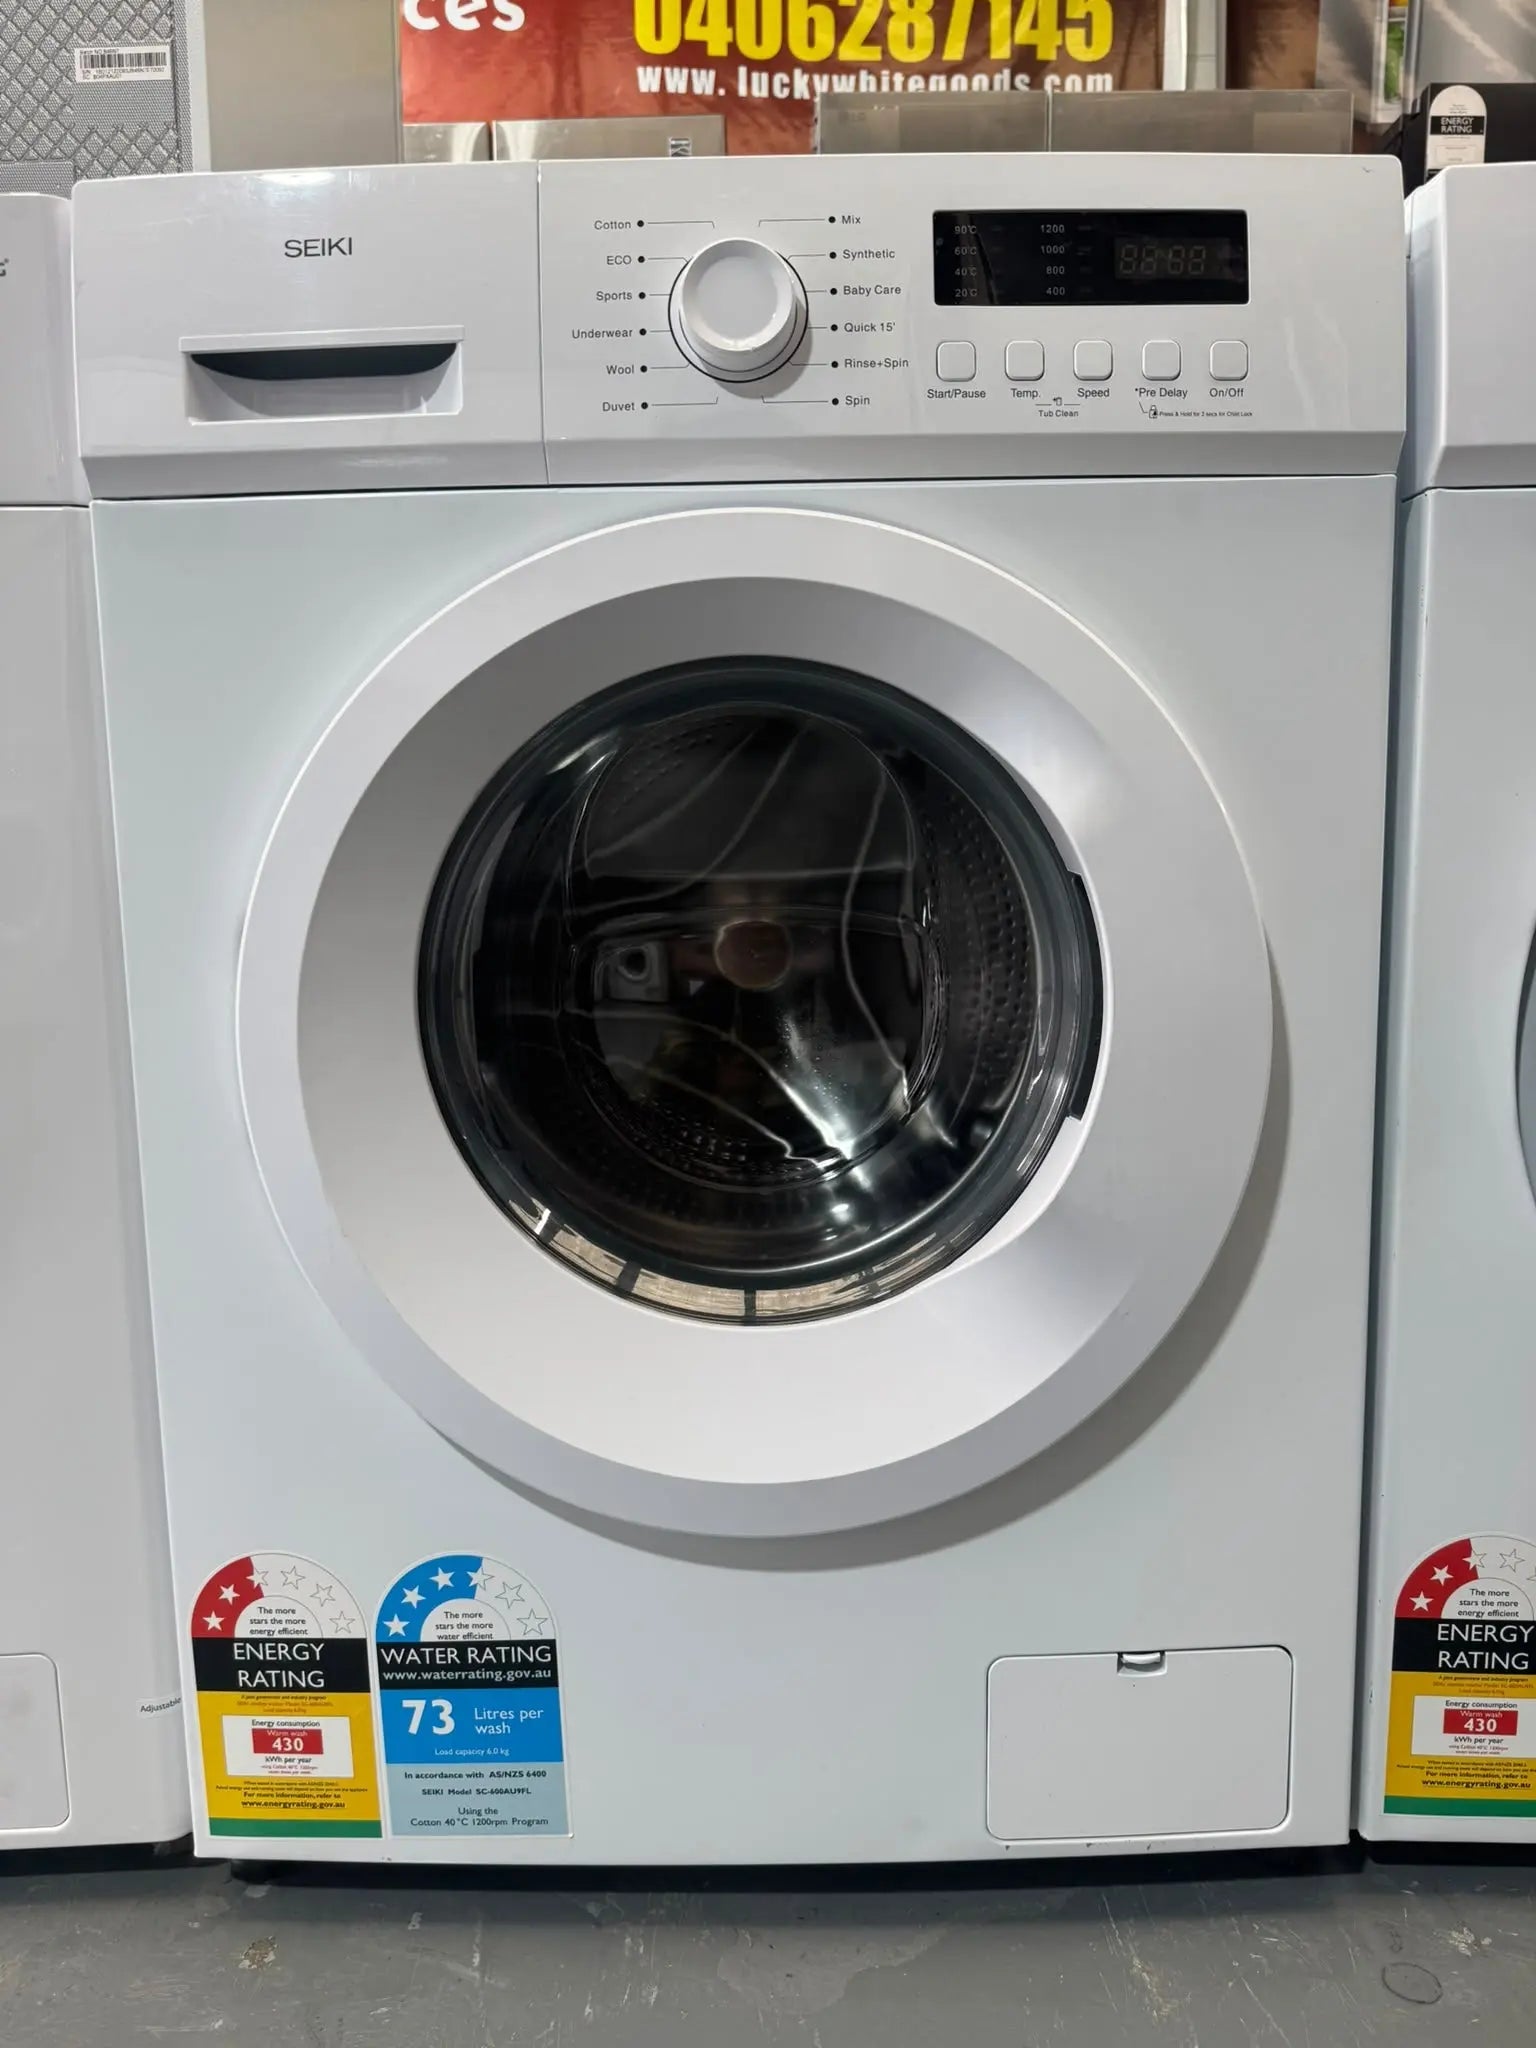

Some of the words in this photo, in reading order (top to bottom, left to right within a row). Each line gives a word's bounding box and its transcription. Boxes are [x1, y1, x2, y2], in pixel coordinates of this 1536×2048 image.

[1440, 117, 1474, 126] ENERGY
[1440, 126, 1473, 134] RATING
[594, 219, 632, 230] Cotton
[842, 214, 861, 225] Mix
[1040, 224, 1065, 234] 1200
[284, 237, 353, 258] SEIKI
[1040, 245, 1065, 255] 1000
[606, 255, 632, 265] ECO
[842, 249, 896, 261] Synthetic
[1046, 266, 1065, 276] 800
[843, 284, 872, 297] Baby
[874, 284, 902, 295] Care
[1046, 287, 1066, 297] 400
[596, 290, 633, 303] Sports
[572, 327, 633, 339] Underwear
[844, 322, 876, 334] Quick
[879, 322, 896, 333] 15'
[606, 364, 635, 375] Wool
[844, 357, 909, 371] Rinse+Spin
[927, 389, 987, 400] Start/Pause
[1010, 388, 1041, 400] Temp.
[1077, 387, 1111, 399] Speed
[1159, 387, 1188, 400] Delay
[1209, 387, 1245, 398] On/Off
[602, 401, 636, 412] Duvet
[845, 395, 871, 408] Spin
[1038, 409, 1053, 417] Tub
[1055, 409, 1079, 417] Clean
[1469, 1588, 1485, 1596] The
[1481, 1599, 1494, 1607] the
[258, 1606, 273, 1615] The
[444, 1611, 459, 1619] The
[1457, 1611, 1485, 1619] energy
[271, 1617, 283, 1625] the
[435, 1622, 454, 1630] stars
[456, 1622, 470, 1630] the
[471, 1622, 493, 1630] more
[250, 1629, 276, 1637] energy
[278, 1628, 308, 1636] efficient
[462, 1632, 493, 1640] efficient
[1437, 1623, 1534, 1643] ENERGY
[233, 1642, 325, 1661] ENERGY
[381, 1647, 460, 1665] WATER
[467, 1646, 552, 1664] RATING
[1438, 1651, 1529, 1670] RATING
[238, 1670, 325, 1688] RATING
[382, 1668, 552, 1682] www.waterrating.gov.au
[1445, 1699, 1469, 1708] Energy
[1471, 1701, 1517, 1709] consumption
[402, 1698, 455, 1735] 73
[474, 1707, 515, 1720] Litres
[520, 1709, 544, 1724] per
[251, 1719, 275, 1728] Energy
[276, 1720, 321, 1728] consumption
[475, 1722, 511, 1735] wash
[1464, 1718, 1497, 1732] 430
[272, 1737, 304, 1752] 430
[435, 1748, 454, 1756] Load
[456, 1748, 485, 1757] capacity
[486, 1748, 498, 1756] 6.0
[499, 1748, 510, 1757] kg
[404, 1771, 413, 1779] In
[414, 1771, 463, 1779] accordance
[465, 1770, 484, 1778] with
[489, 1770, 525, 1778] AS/NZS
[526, 1769, 547, 1778] 6400
[1422, 1780, 1531, 1789] www.energyrating.gov.au
[422, 1788, 444, 1796] SEIKI
[448, 1788, 472, 1796] Model
[241, 1800, 346, 1809] www.energyrating.gov.au
[458, 1806, 485, 1816] Using
[487, 1806, 498, 1815] the
[410, 1818, 443, 1826] Cotton
[472, 1817, 508, 1828] 1200rpm
[511, 1817, 549, 1827] Program
